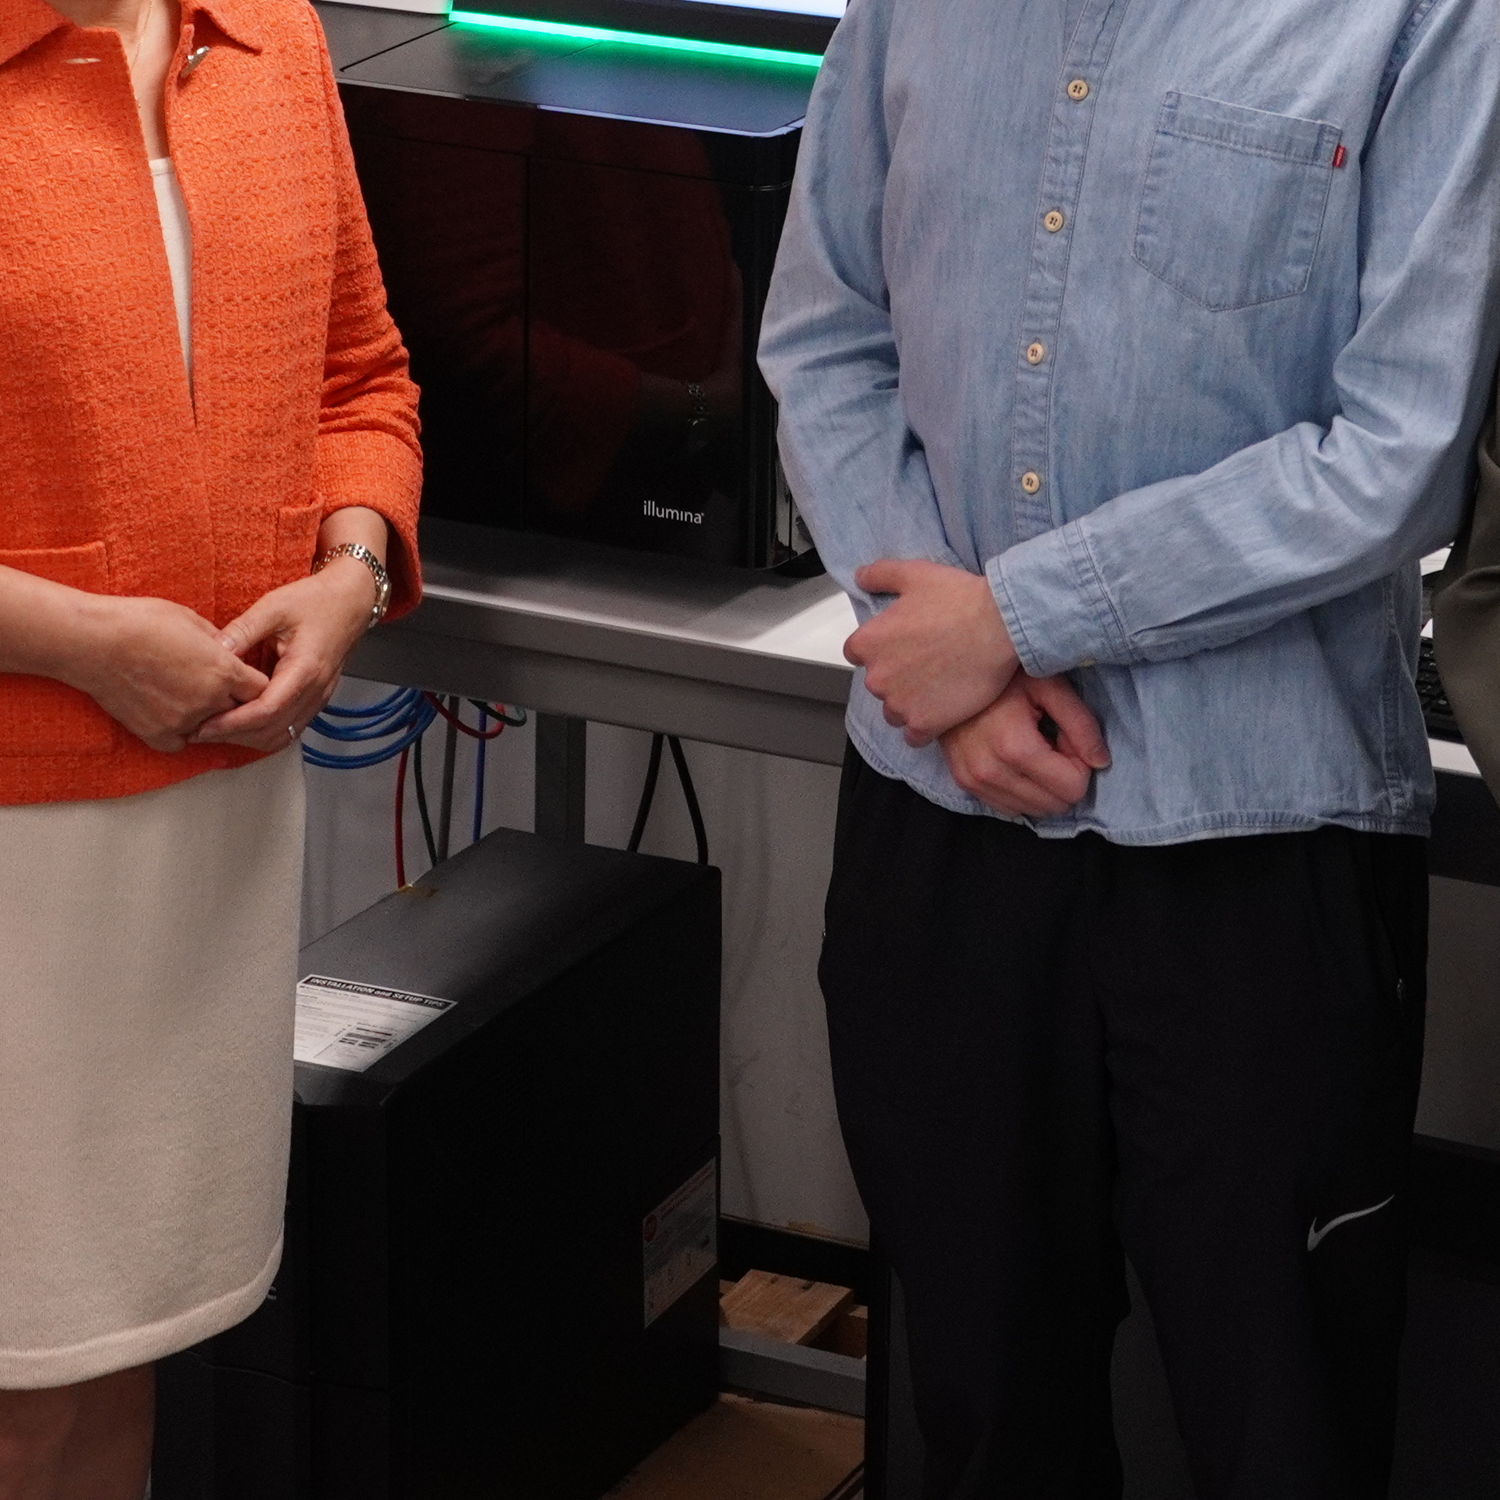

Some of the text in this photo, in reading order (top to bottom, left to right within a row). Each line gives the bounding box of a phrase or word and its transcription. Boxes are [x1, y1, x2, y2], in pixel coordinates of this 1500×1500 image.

[643, 500, 702, 524] illumina
[309, 977, 373, 993] INSTALLATION
[373, 990, 391, 999] and
[392, 992, 423, 1003] SETUP
